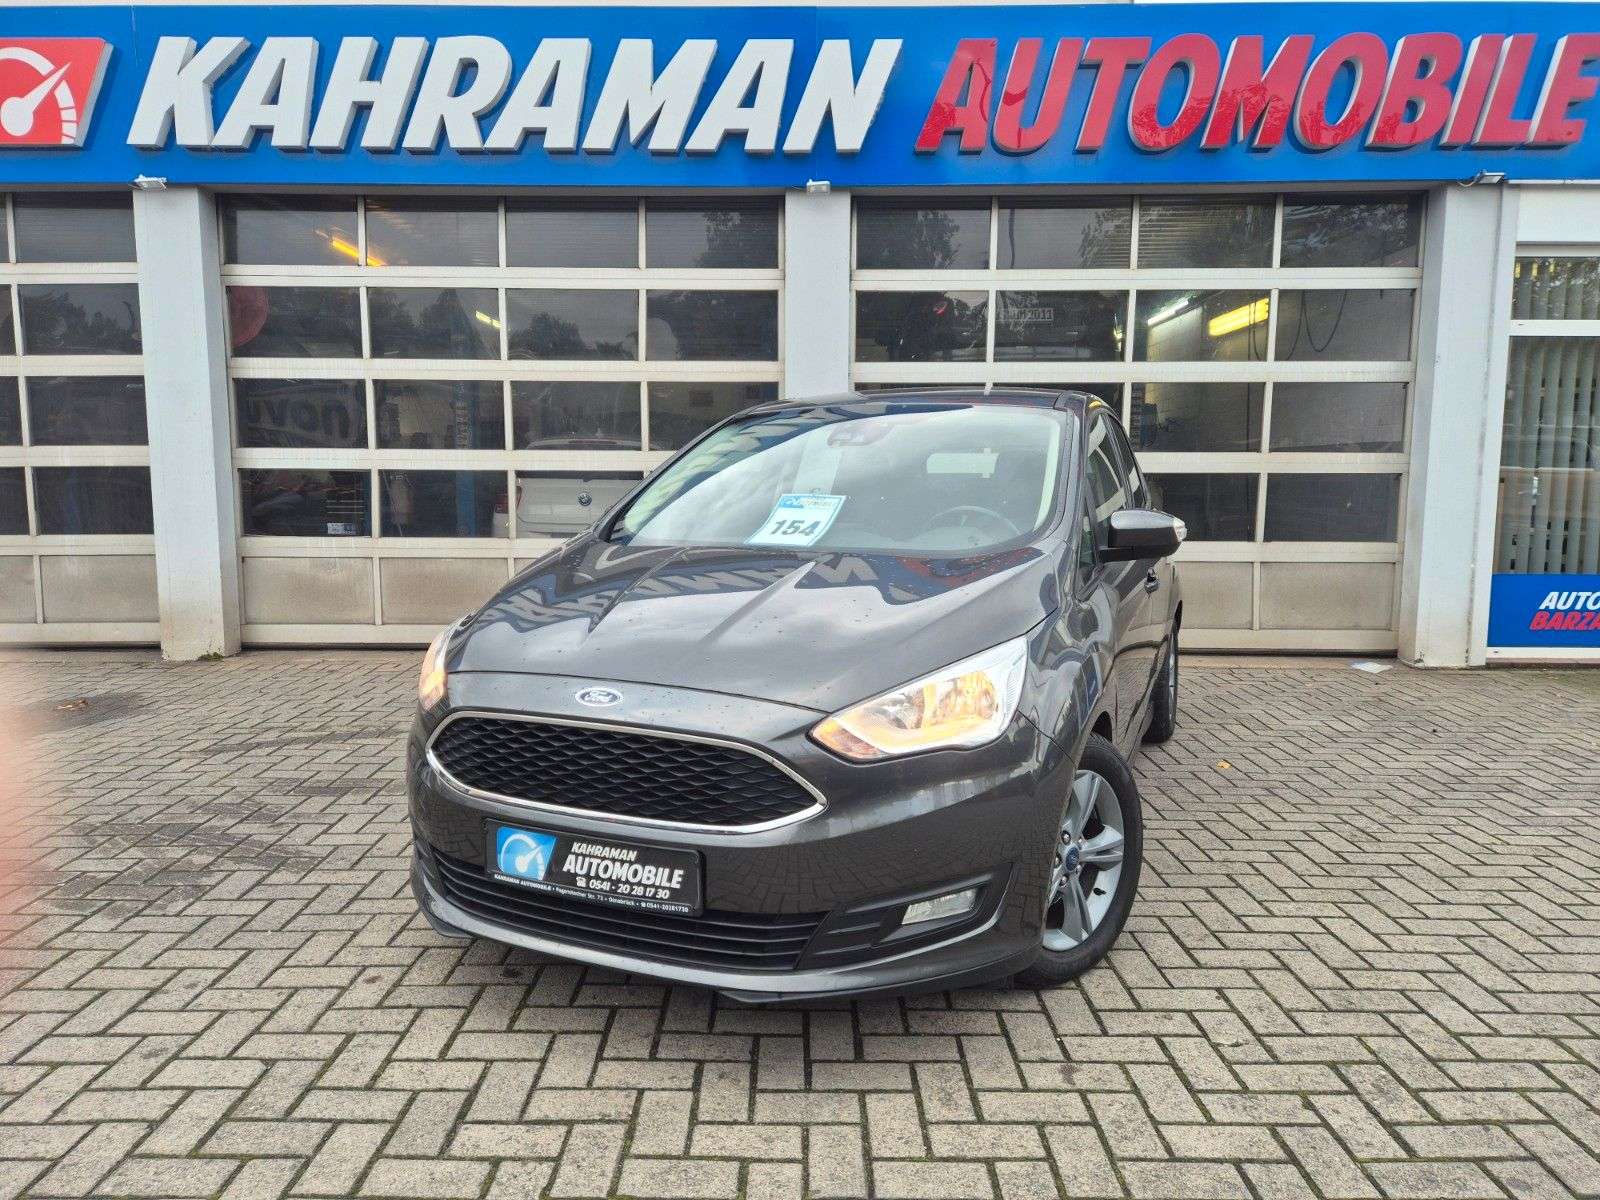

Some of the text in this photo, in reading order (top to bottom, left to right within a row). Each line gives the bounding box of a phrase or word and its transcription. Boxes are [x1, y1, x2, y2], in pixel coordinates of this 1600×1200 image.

[126, 31, 1600, 155] KAHRAMAN AUTOMOBILE
[770, 519, 822, 537] 154
[571, 841, 637, 862] KAHRAMAN
[562, 853, 684, 889] AUTOMOBILE
[589, 878, 671, 900] 0541 20 28 17 30
